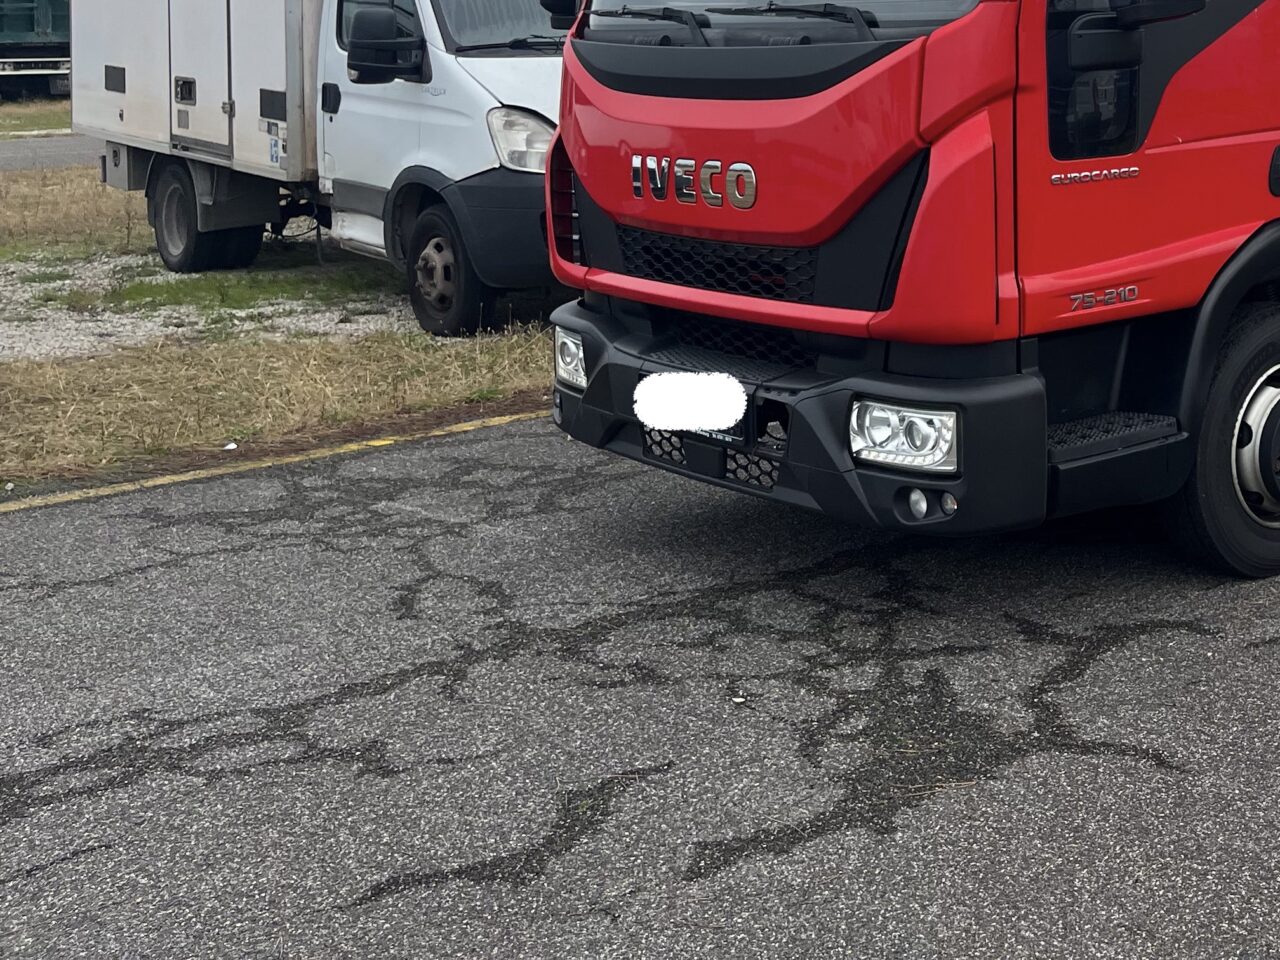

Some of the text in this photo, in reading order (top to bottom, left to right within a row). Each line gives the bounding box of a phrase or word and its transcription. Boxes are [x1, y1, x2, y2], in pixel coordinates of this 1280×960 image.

[632, 154, 758, 210] IVECO
[1051, 167, 1140, 185] EUROCARGO
[1070, 285, 1138, 311] 75-210
